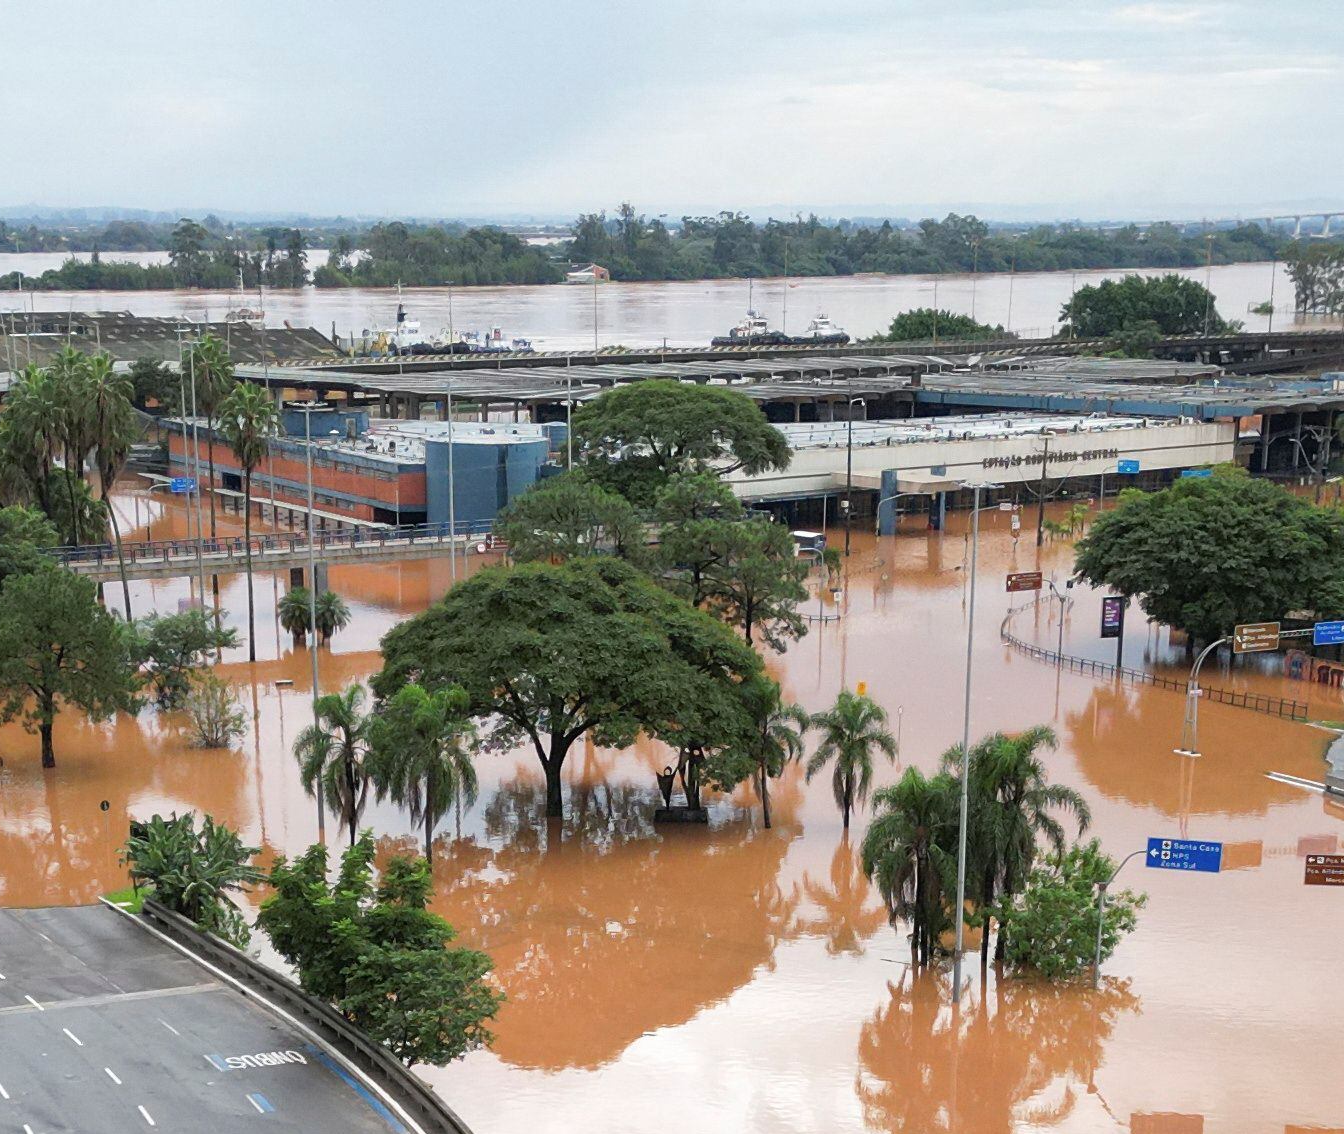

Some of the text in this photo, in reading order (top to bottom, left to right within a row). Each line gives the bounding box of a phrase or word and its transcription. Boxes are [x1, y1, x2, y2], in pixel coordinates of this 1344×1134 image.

[1173, 842, 1220, 853] Santa Casa
[1172, 852, 1190, 861] HPS
[1160, 860, 1196, 869] Zona Sul
[224, 1050, 308, 1069] ÔNIBUS
